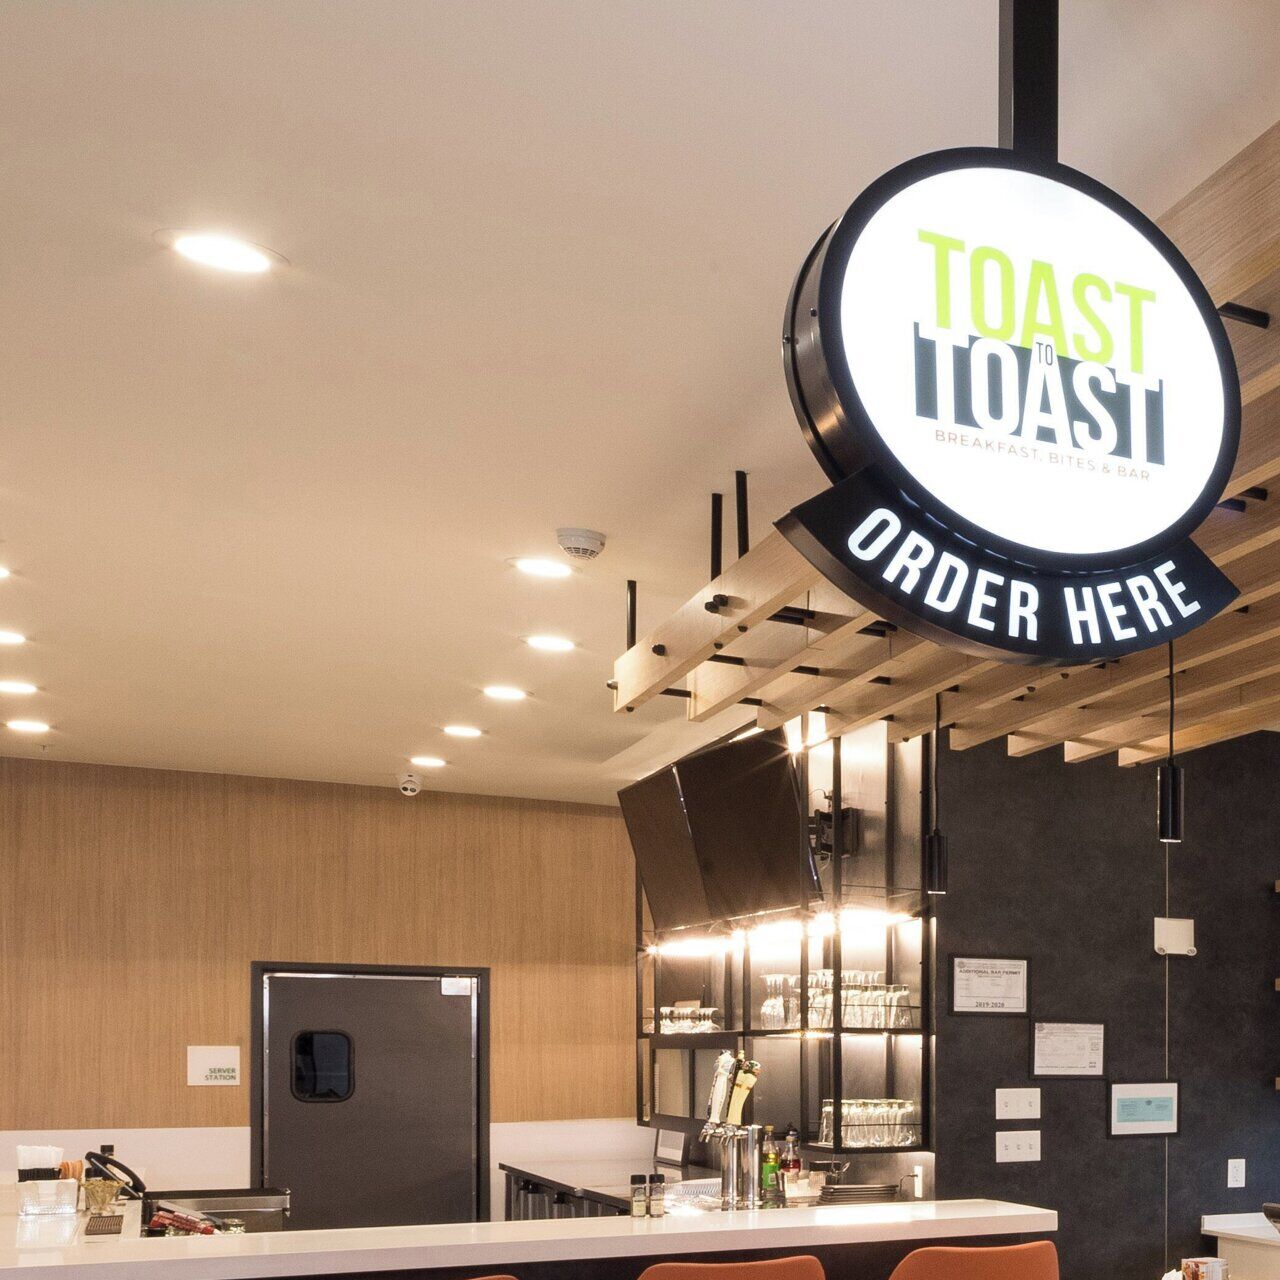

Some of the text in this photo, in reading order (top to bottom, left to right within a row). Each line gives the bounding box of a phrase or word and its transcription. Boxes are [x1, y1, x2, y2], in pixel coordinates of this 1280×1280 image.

[918, 229, 1156, 374] TOAST
[1035, 340, 1054, 367] TO
[914, 321, 1166, 466] TOAST
[935, 429, 1151, 482] BREAKFAST, BITES & BAR
[847, 506, 1202, 645] ORDER HERE
